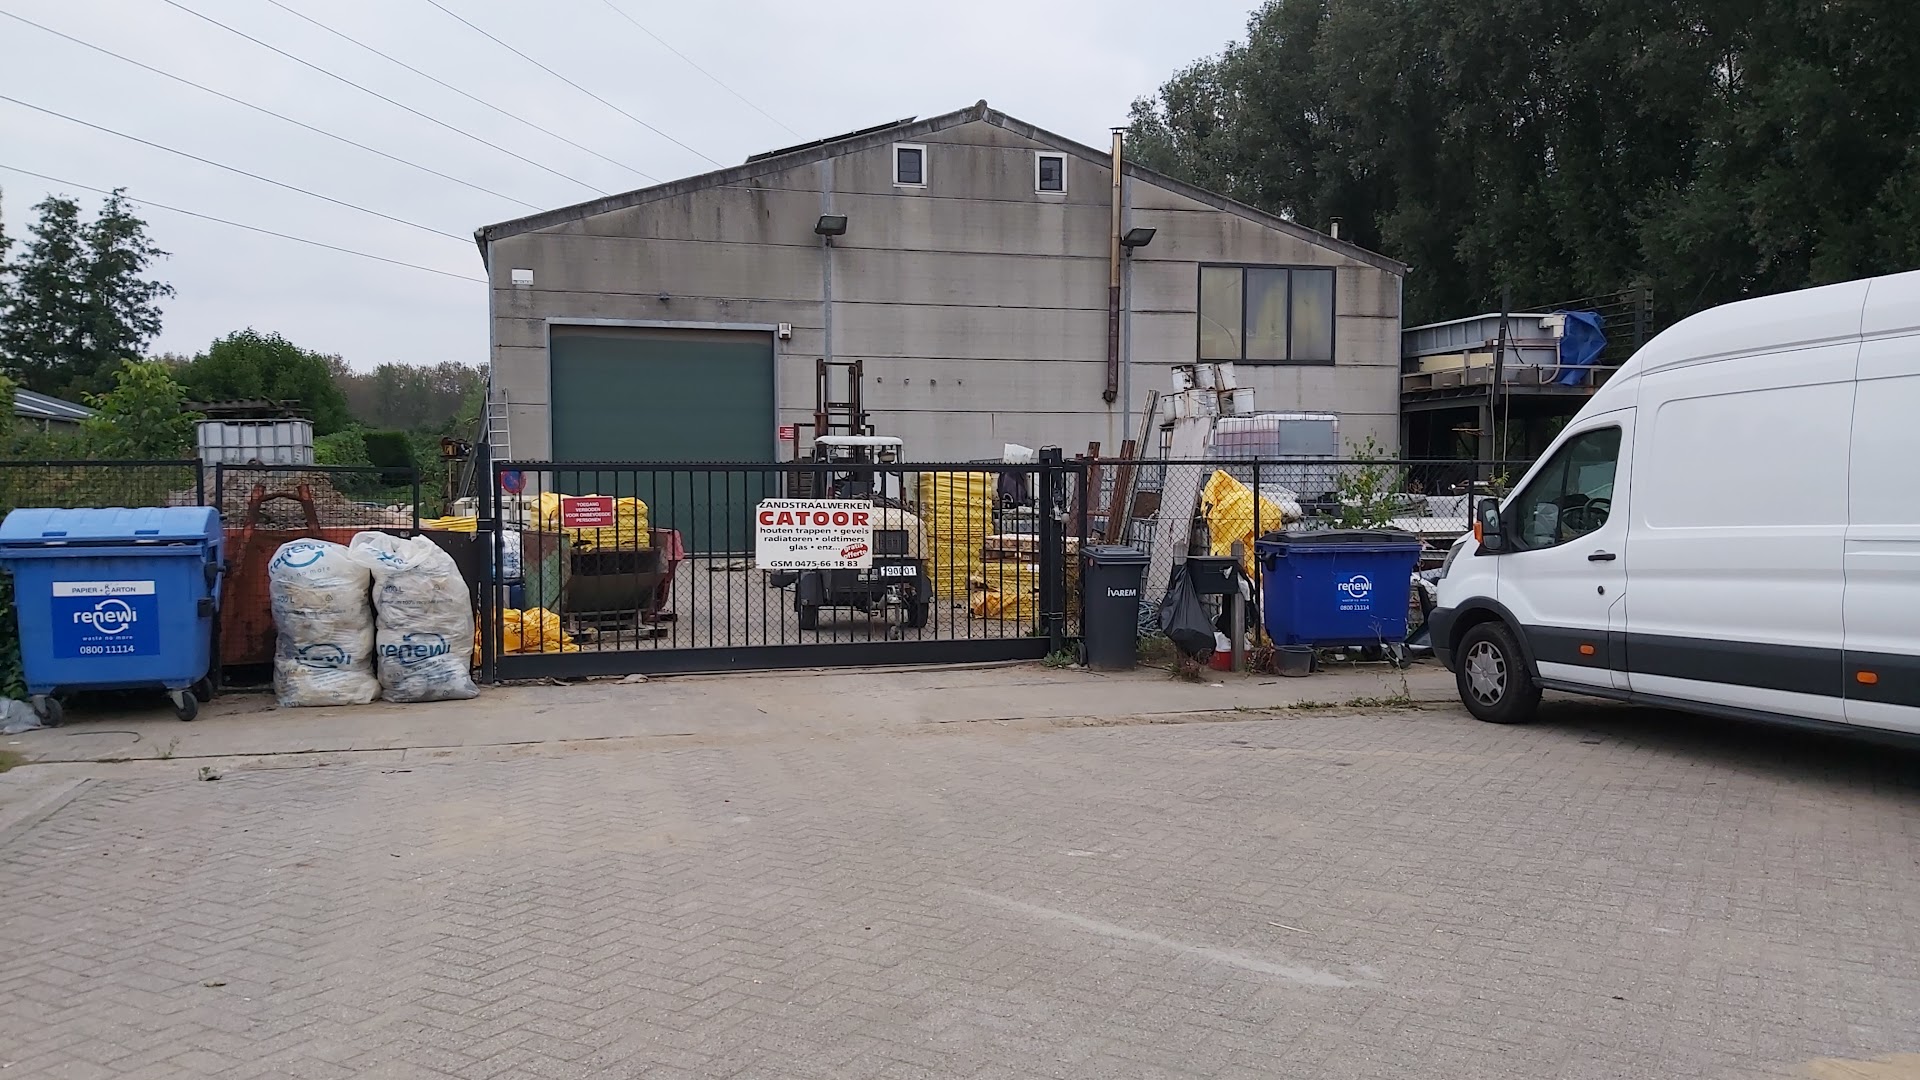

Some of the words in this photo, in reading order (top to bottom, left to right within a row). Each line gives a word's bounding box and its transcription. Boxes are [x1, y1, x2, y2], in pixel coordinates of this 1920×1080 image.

[759, 501, 871, 510] ZANDSTRAALWERKEN
[759, 511, 870, 526] CATOOR
[840, 527, 870, 535] gevels
[72, 605, 138, 625] renewi
[79, 645, 104, 655] 0800
[105, 644, 135, 654] 11114
